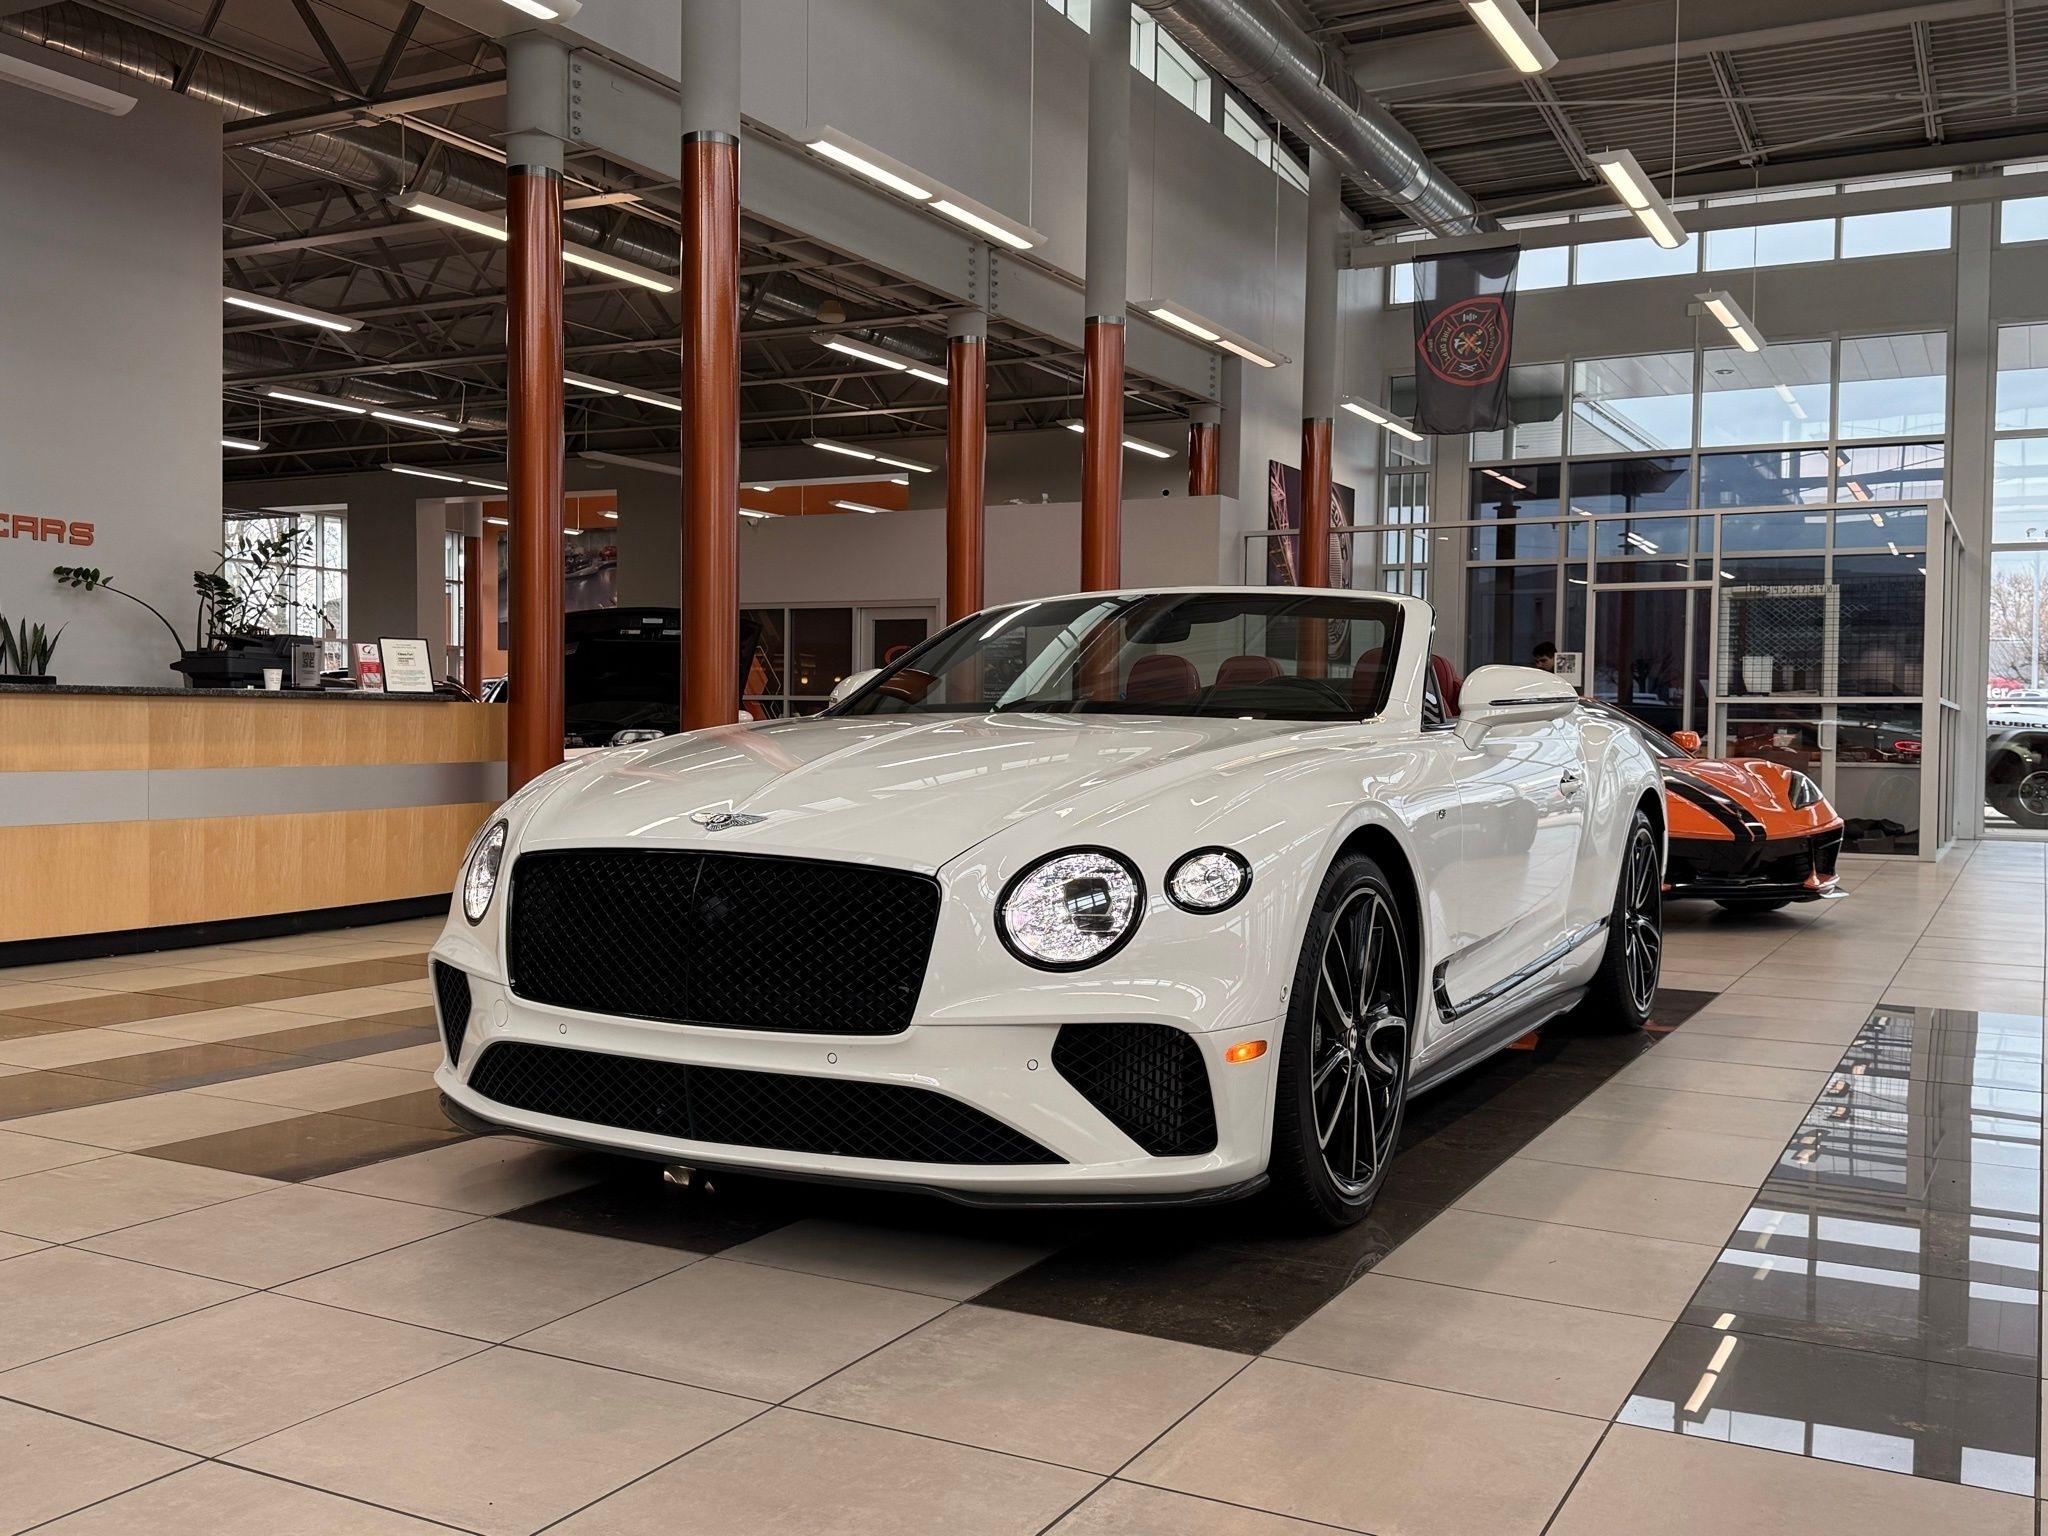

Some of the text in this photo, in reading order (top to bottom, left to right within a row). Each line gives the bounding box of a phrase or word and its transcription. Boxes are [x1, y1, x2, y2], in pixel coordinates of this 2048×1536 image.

[1440, 327, 1452, 361] FIRE DEPT
[302, 658, 315, 668] SE
